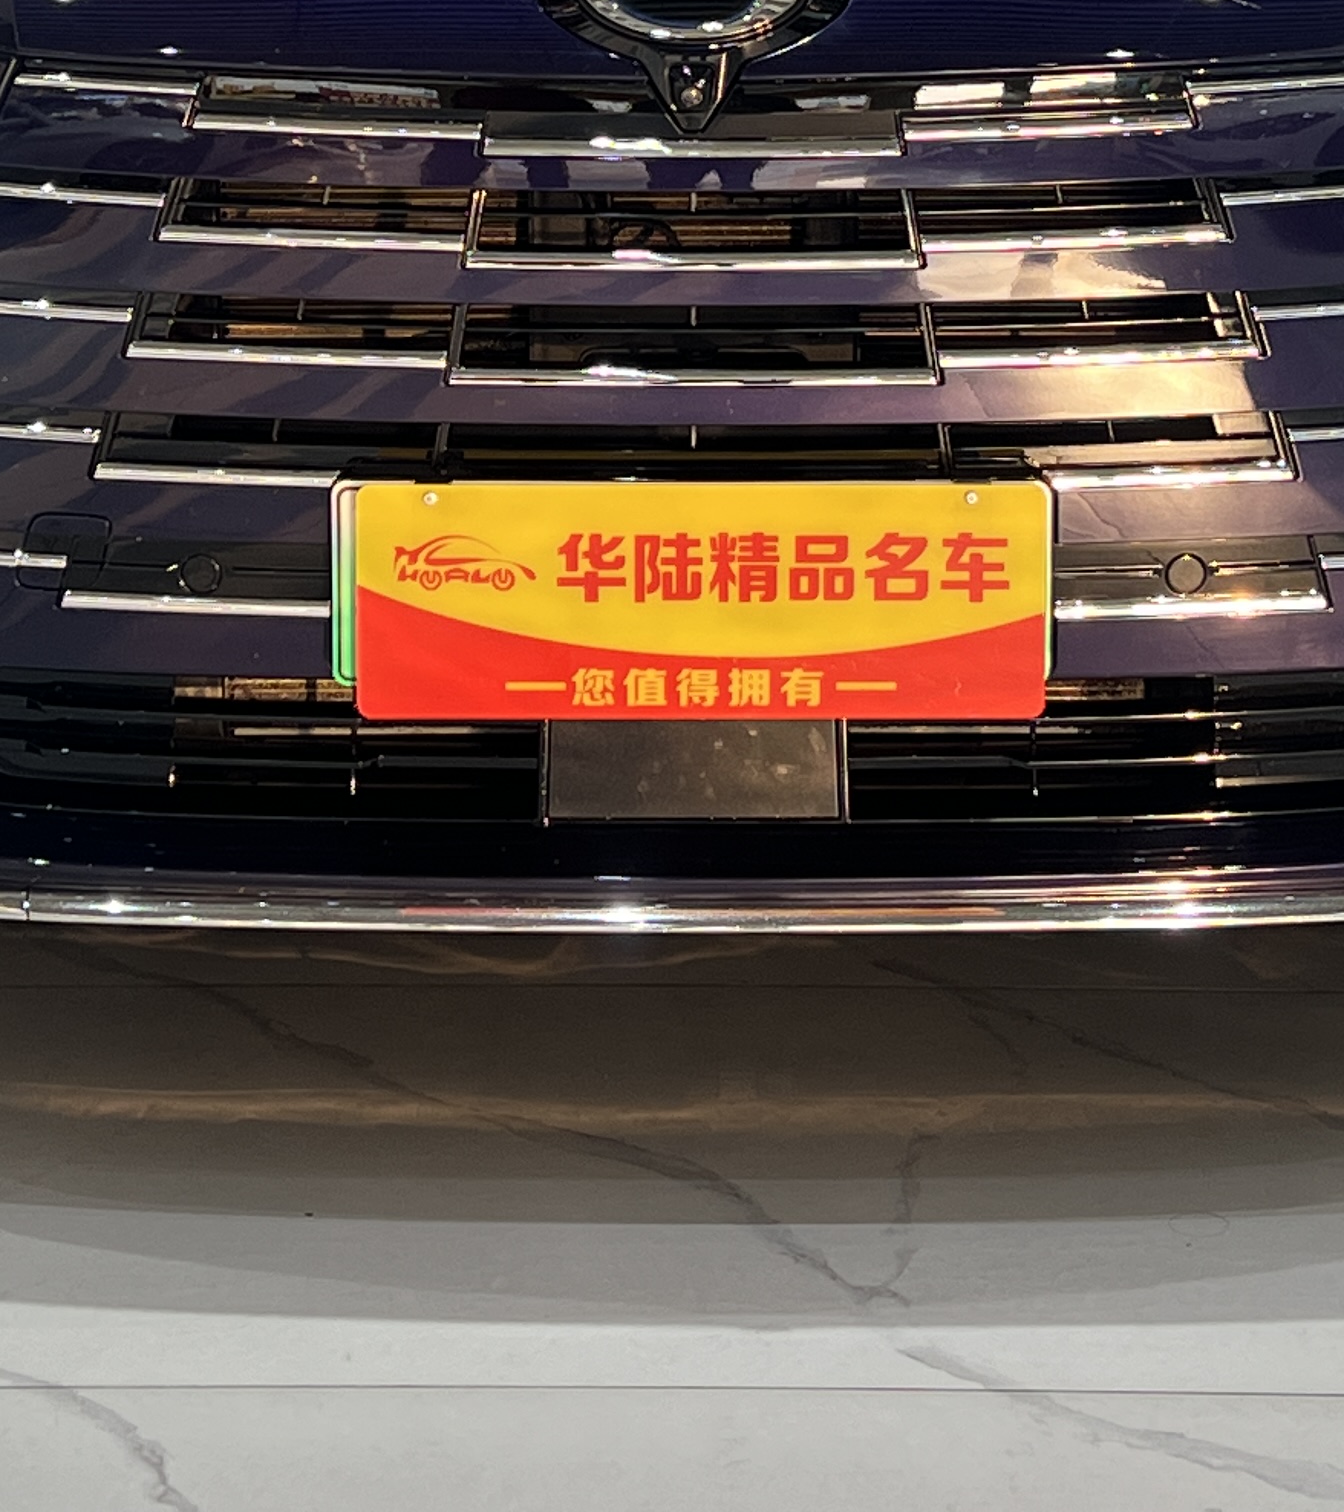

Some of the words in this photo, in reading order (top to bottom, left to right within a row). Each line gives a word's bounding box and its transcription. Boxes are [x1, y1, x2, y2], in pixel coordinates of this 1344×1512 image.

[556, 532, 1010, 604] 华陆精品名车
[571, 667, 825, 708] 您值得拥有
